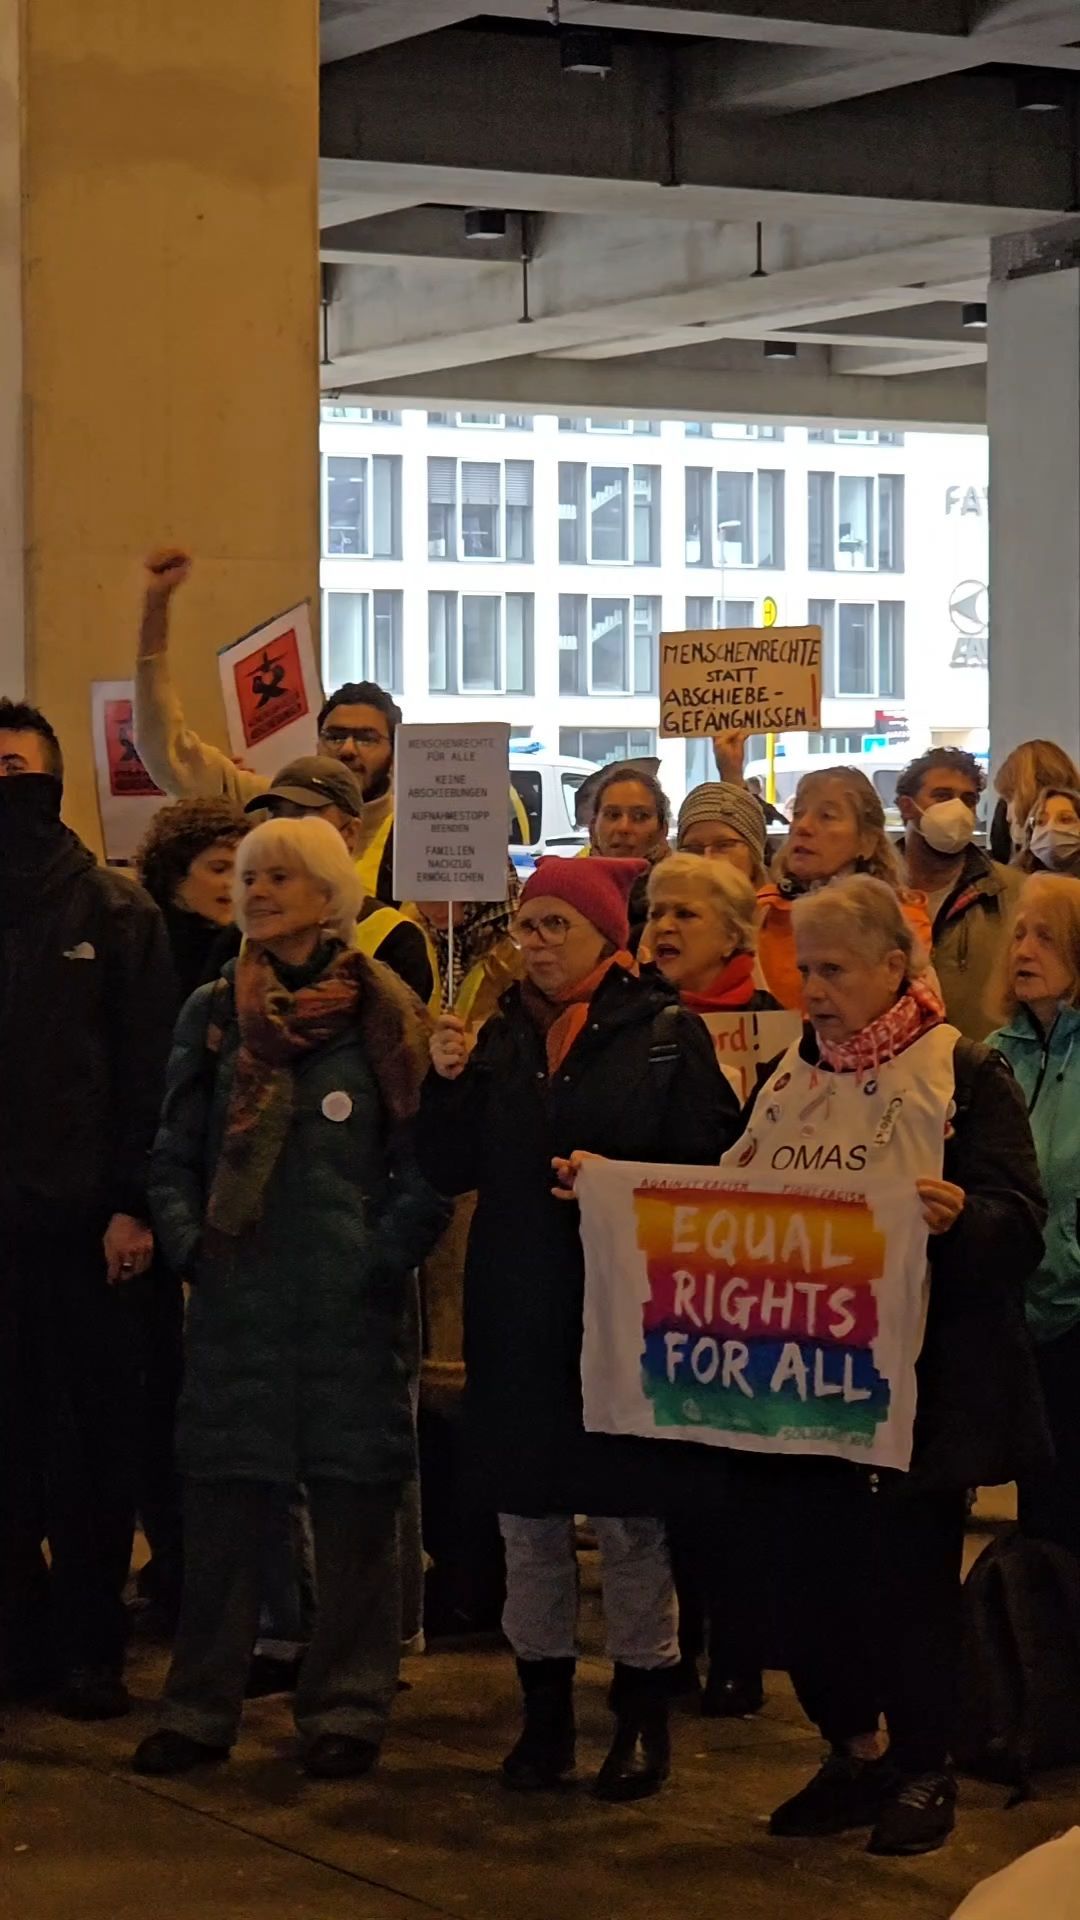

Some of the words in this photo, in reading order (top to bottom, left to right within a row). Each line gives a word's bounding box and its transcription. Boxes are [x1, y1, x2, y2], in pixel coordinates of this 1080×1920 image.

[945, 486, 989, 516] FA
[663, 639, 821, 666] MENSCHENRECHTE
[706, 667, 758, 683] STATT
[408, 738, 495, 749] MENSCHENRECHTE
[427, 751, 445, 762] FÜR
[451, 753, 476, 762] ALLE
[434, 775, 466, 785] KEINE
[408, 788, 488, 798] ABSCHIEBUNGEN
[411, 811, 490, 821] AUFNAHMESTOPP
[430, 824, 469, 833] BEENDEN
[425, 846, 475, 856] FAMILIEN
[428, 859, 472, 869] NACHZUG
[416, 871, 484, 882] ERMÖGLICHEN
[771, 1145, 867, 1171] OMAS
[671, 1206, 854, 1274] EQUAL
[672, 1270, 857, 1338] RIGHTS
[664, 1331, 754, 1398] FOR
[769, 1342, 872, 1403] ALL
